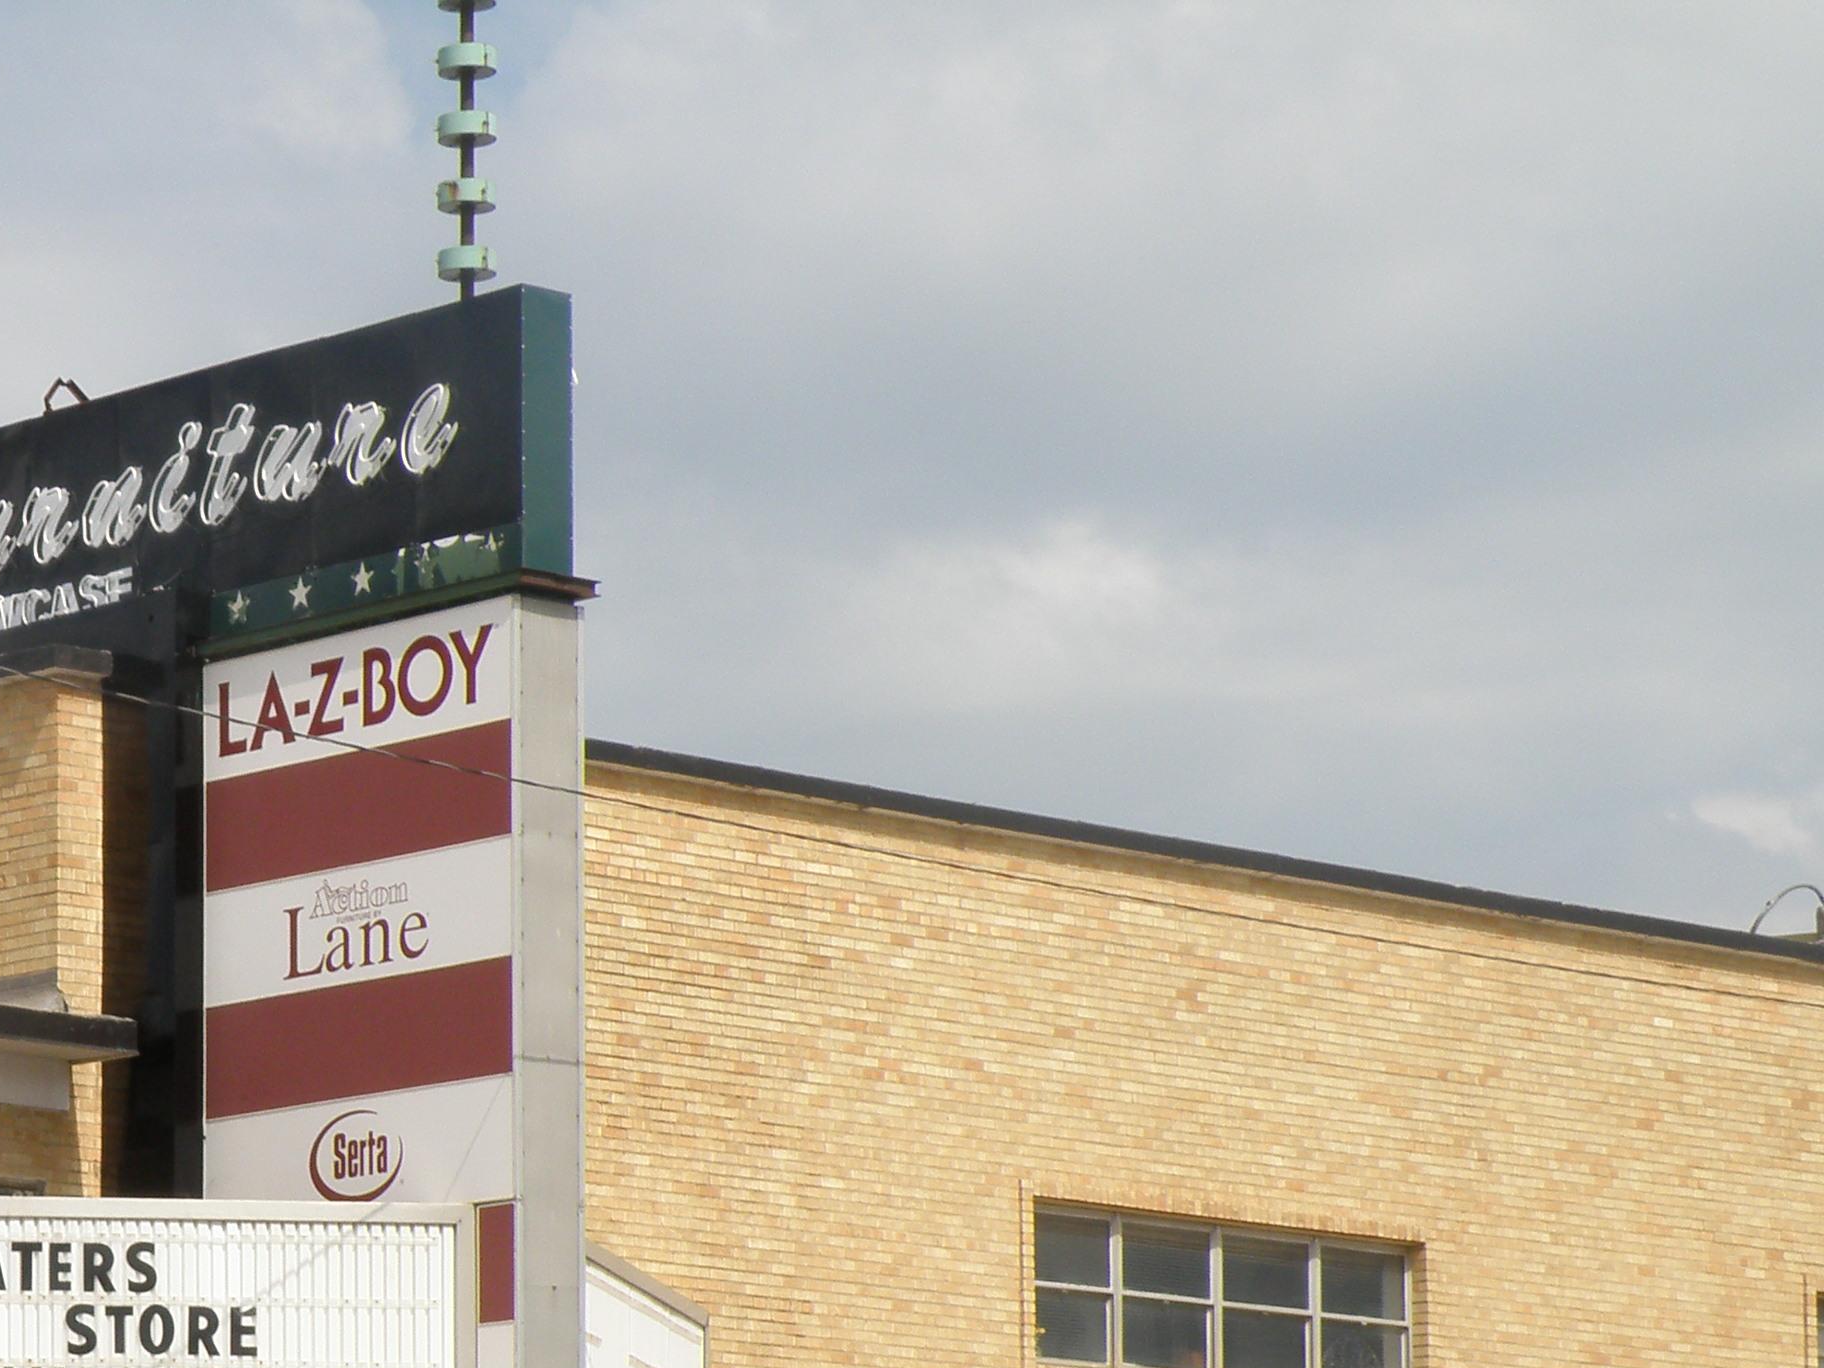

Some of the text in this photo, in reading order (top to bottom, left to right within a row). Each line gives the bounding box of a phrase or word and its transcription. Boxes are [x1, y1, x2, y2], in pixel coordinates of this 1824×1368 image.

[219, 623, 494, 757] LA-Z-BOY
[308, 879, 408, 919] Action
[283, 906, 429, 980] Lane
[333, 1130, 388, 1180] Serta
[66, 1304, 257, 1356] STORE
